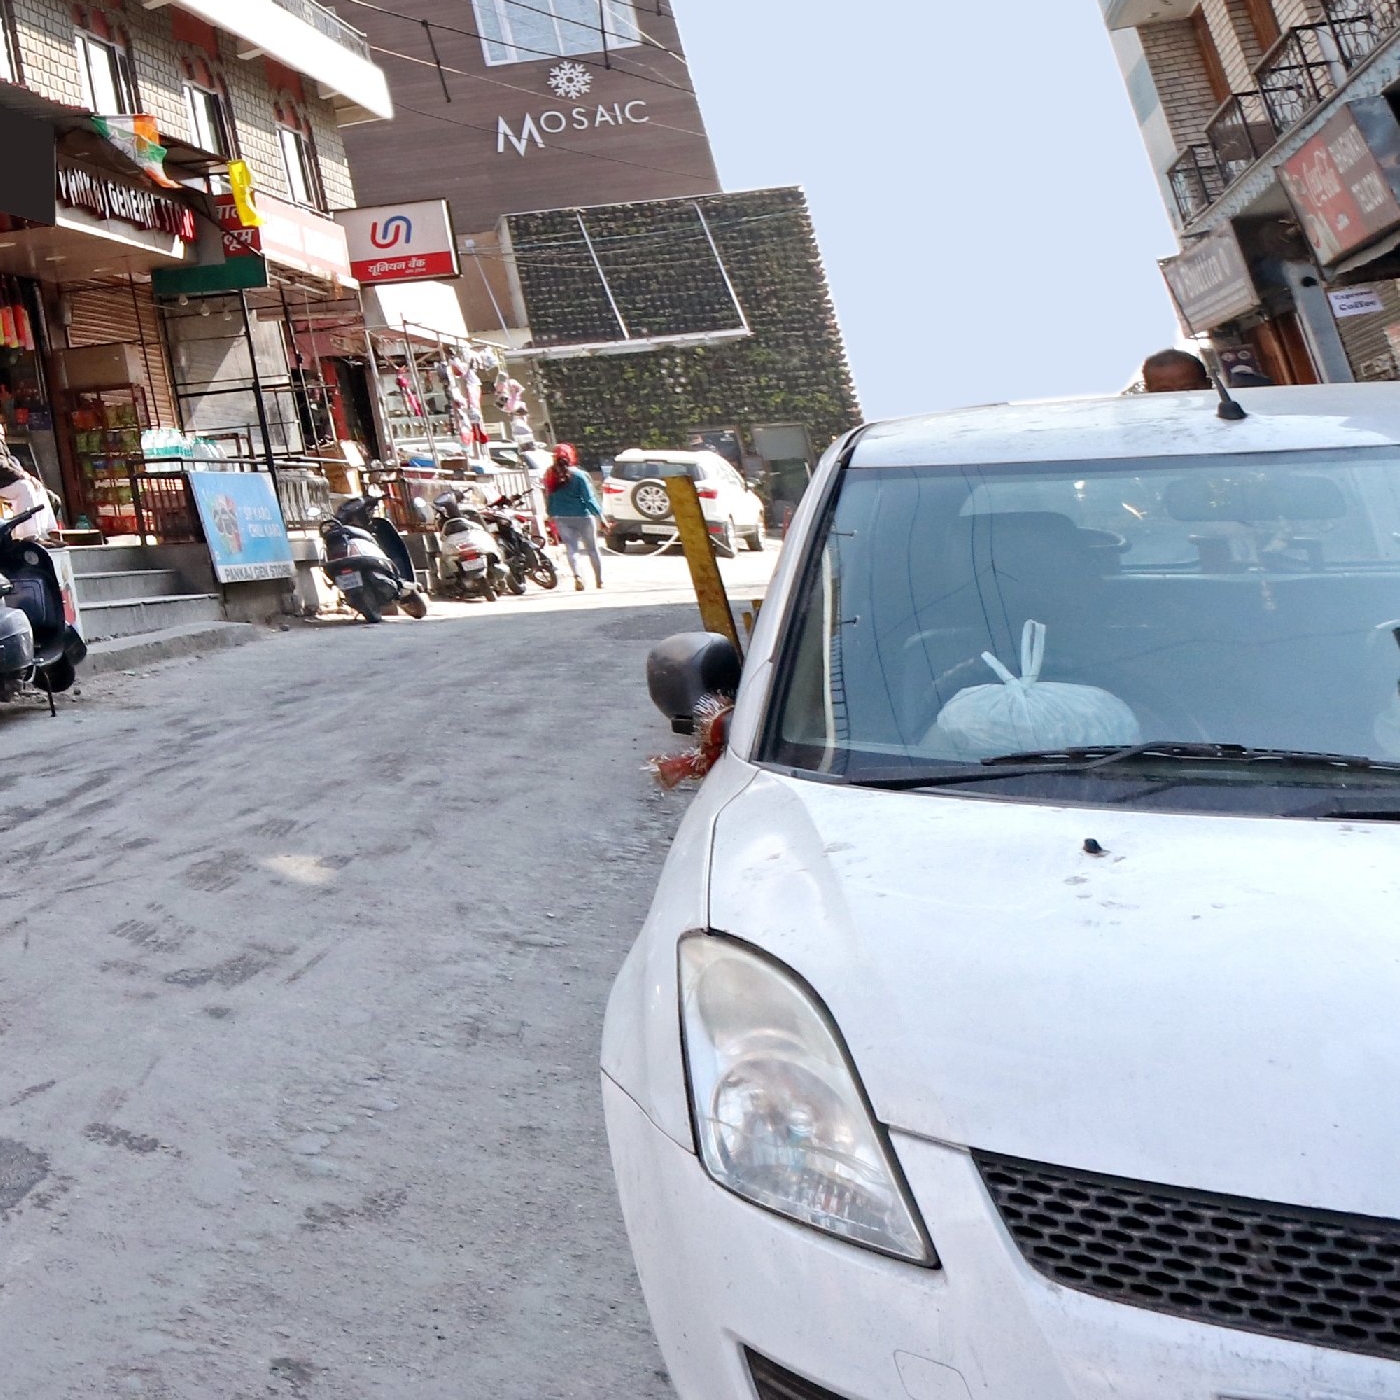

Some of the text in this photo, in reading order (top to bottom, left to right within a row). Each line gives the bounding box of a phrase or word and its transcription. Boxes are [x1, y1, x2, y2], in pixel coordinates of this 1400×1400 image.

[496, 99, 649, 157] MOSAIC
[367, 261, 406, 277] यूनियन
[225, 567, 253, 580] PANKAJ
[254, 565, 268, 579] GEN
